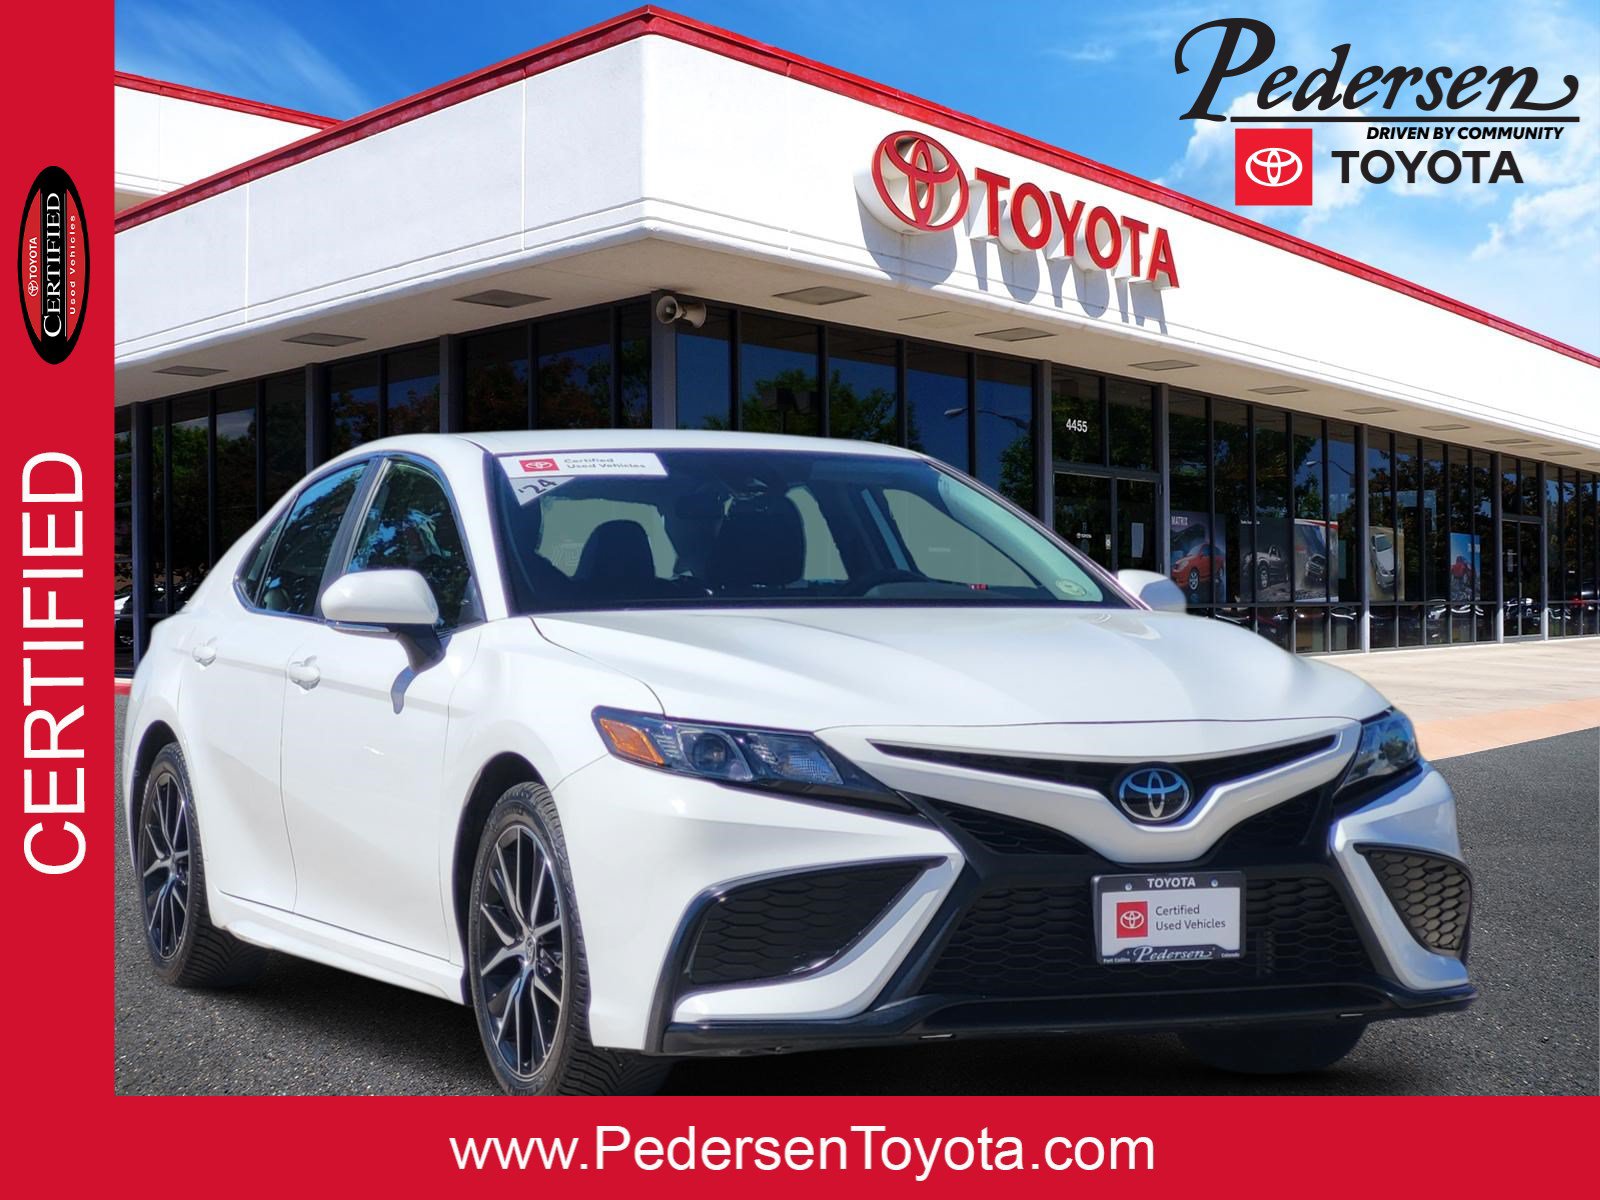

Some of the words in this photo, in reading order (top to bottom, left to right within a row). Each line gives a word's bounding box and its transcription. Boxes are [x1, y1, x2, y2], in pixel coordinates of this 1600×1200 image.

[975, 167, 1180, 289] TOYOTA
[1065, 418, 1088, 433] 4455
[1171, 516, 1188, 526] MATRIX
[1147, 876, 1196, 889] TOYOTA
[1155, 904, 1200, 916] Certified
[1155, 919, 1182, 931] Used
[1184, 918, 1226, 930] Vehicles
[1132, 946, 1213, 962] Pedersen
